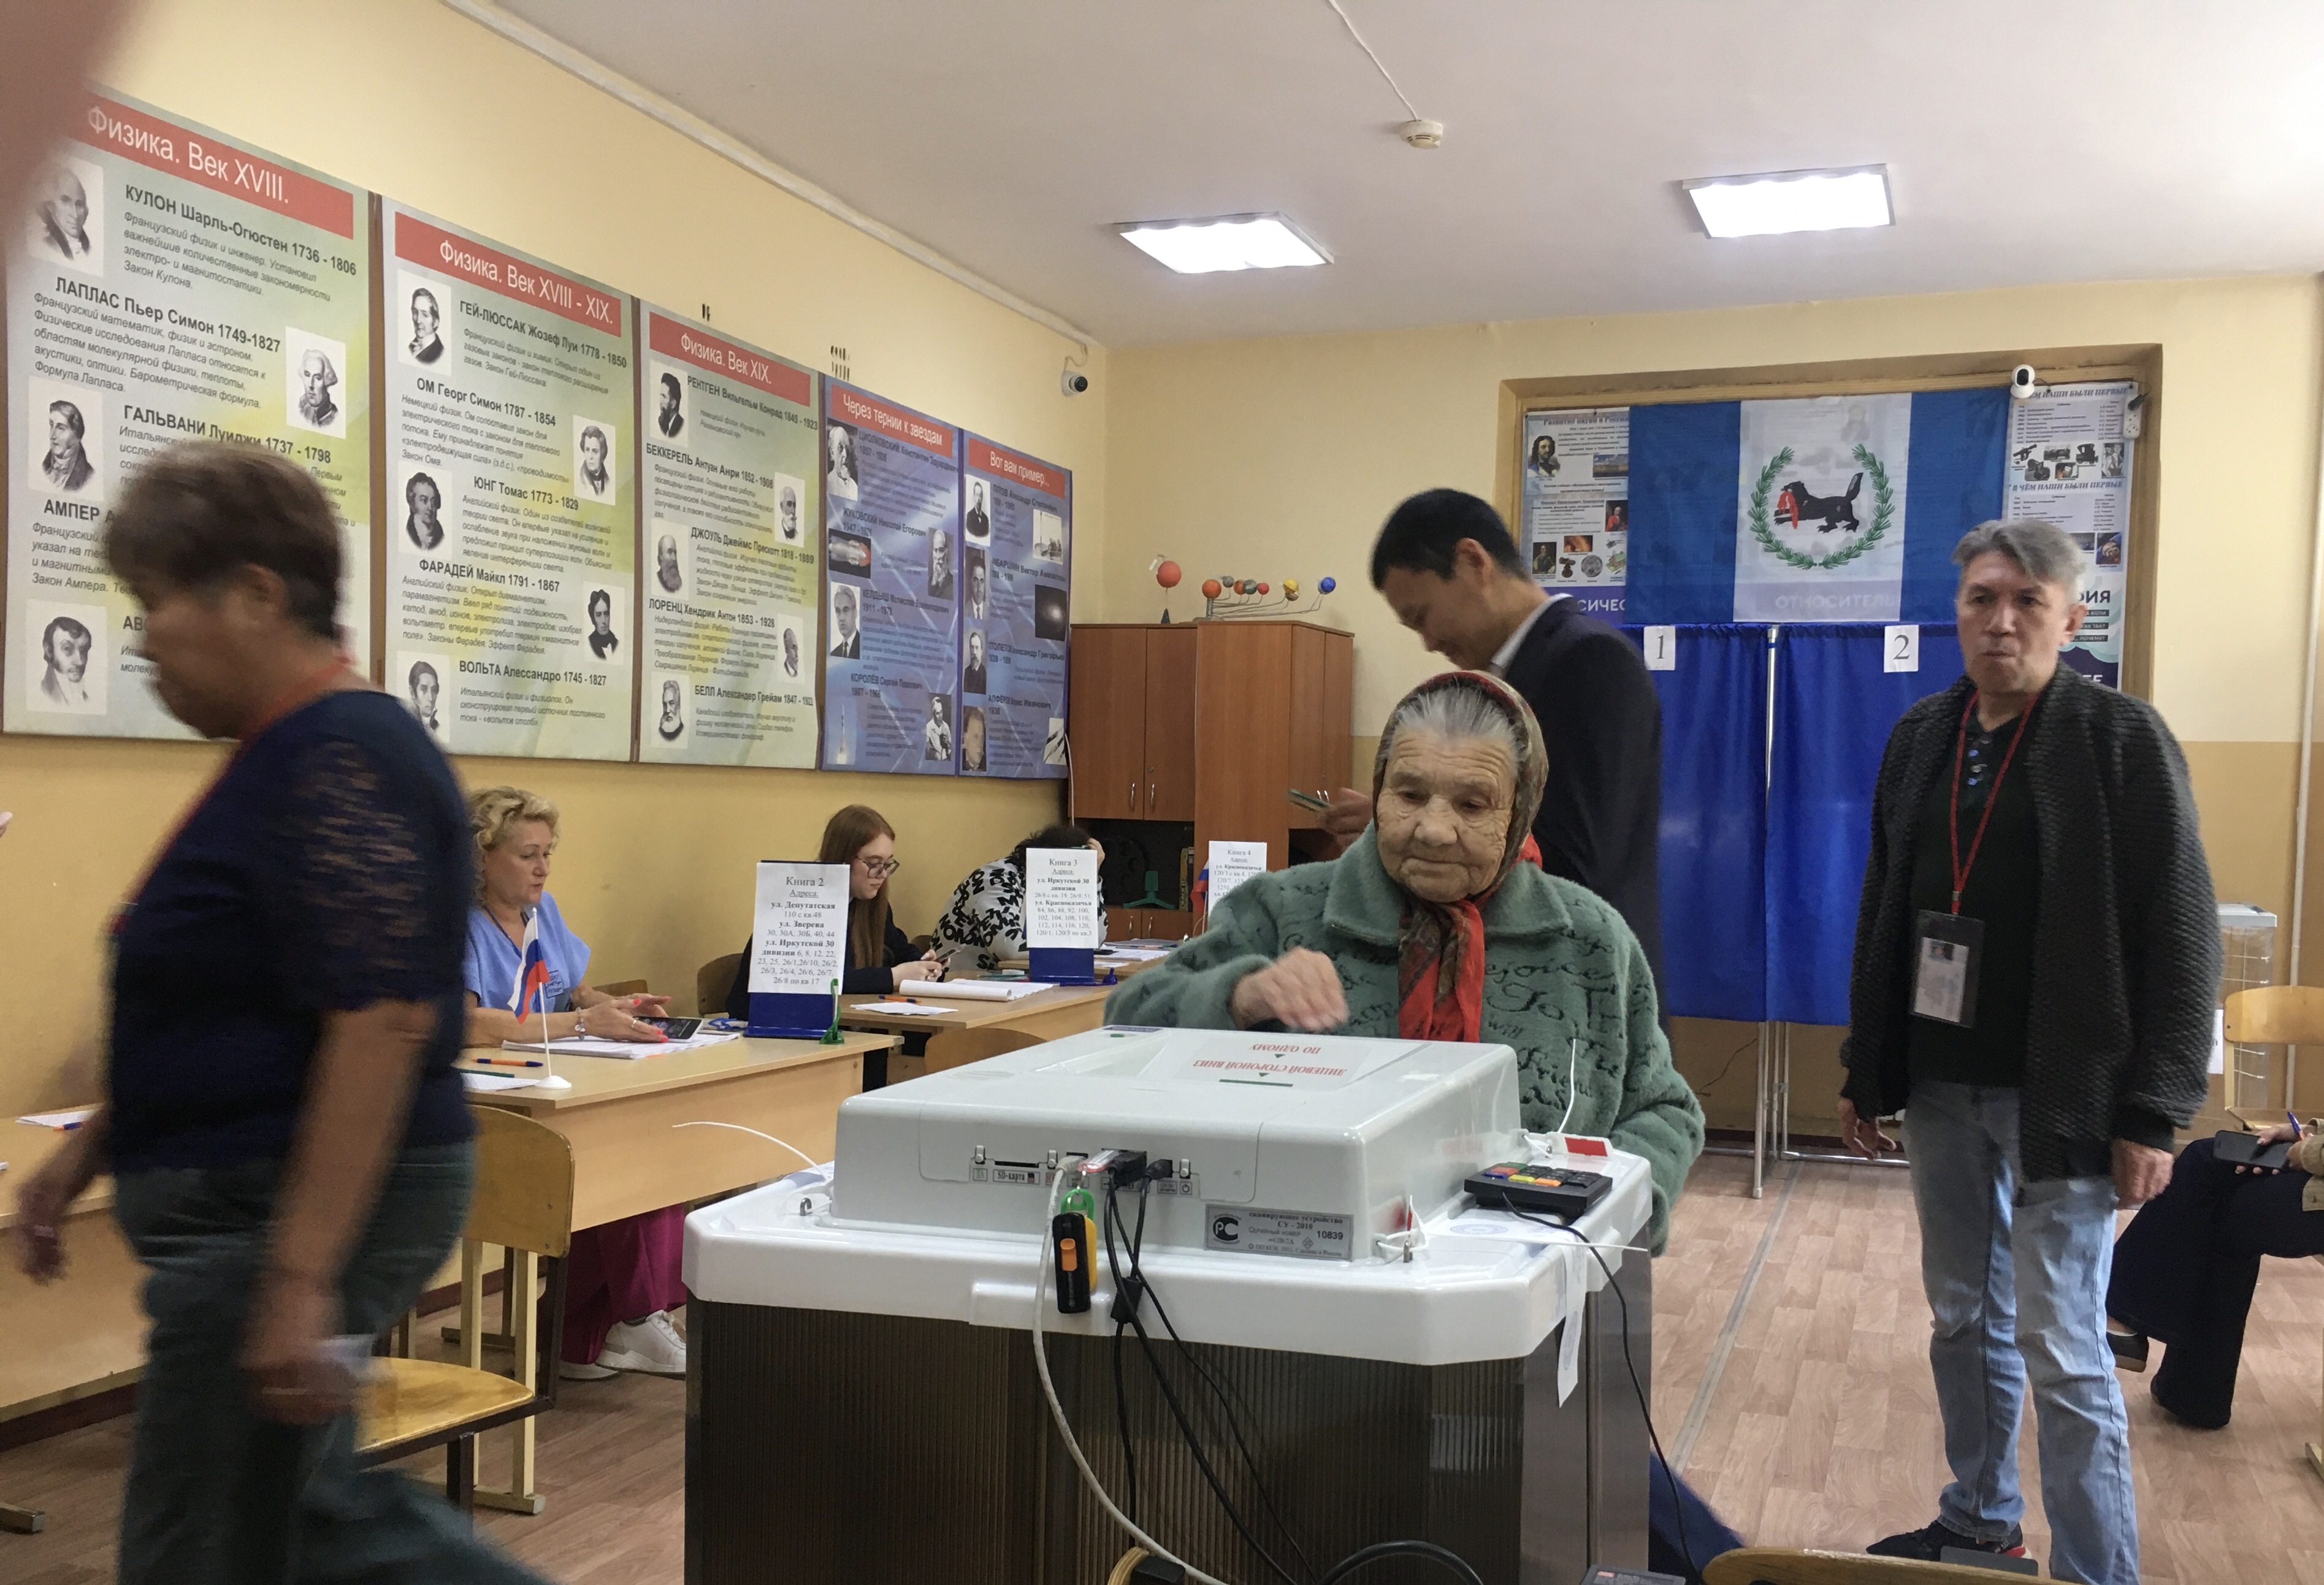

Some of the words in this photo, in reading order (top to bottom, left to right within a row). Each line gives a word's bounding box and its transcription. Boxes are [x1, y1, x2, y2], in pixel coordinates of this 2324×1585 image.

[88, 105, 179, 163] Физика.
[189, 142, 228, 181] Век
[234, 159, 288, 203] XVIII.
[126, 185, 176, 214] КУЛОН
[182, 203, 287, 252] Шарль-Огюстен
[292, 243, 319, 262] 1736
[331, 256, 356, 275] 1806
[124, 212, 188, 240] Французский
[190, 233, 218, 250] физик
[228, 247, 266, 266] инженер.
[270, 259, 316, 281] Установил
[124, 229, 180, 253] важнейшие
[183, 248, 258, 278] количественные
[261, 273, 330, 301] закономерности
[124, 246, 170, 265] электро-
[182, 263, 262, 295] магнитостатики.
[124, 260, 153, 277] Закон
[156, 269, 193, 289] Кулона.
[440, 240, 502, 283] Физика.
[508, 264, 535, 295] Век
[539, 277, 571, 308] XVIII
[586, 294, 612, 324] XIX.
[34, 292, 98, 319] Французский
[101, 313, 164, 338] математик,
[168, 330, 197, 345] физик
[207, 342, 252, 361] астроном.
[56, 277, 119, 308] ЛАПЛАС
[124, 297, 163, 323] Пьер
[168, 309, 213, 334] Симон
[218, 324, 280, 352] 1749-1827
[34, 310, 93, 334] Физические
[95, 329, 165, 353] исследования
[167, 345, 206, 364] Лапласа
[208, 358, 259, 377] относятся
[460, 300, 526, 334] ГЕЙ-ЛЮССАК
[528, 324, 559, 347] Жозеф
[562, 337, 577, 352] Луи
[581, 343, 600, 359] 1778
[607, 353, 626, 368] 1850
[34, 327, 85, 348] областям
[87, 343, 159, 367] молекулярной
[161, 360, 197, 377] физики,
[201, 372, 245, 390] теплоты,
[681, 333, 725, 366] Физика.
[728, 350, 747, 375] Век
[751, 359, 771, 384] XIX.
[34, 345, 83, 367] акустики,
[86, 359, 126, 376] оптики.
[130, 367, 217, 397] Барометрическая
[219, 391, 260, 408] формула.
[35, 361, 78, 380] Формула
[81, 372, 124, 392] Лапласа.
[417, 378, 434, 393] ОМ
[438, 383, 467, 403] Георг
[470, 392, 501, 411] Симон
[504, 403, 525, 418] 1787
[534, 411, 556, 426] 1854
[124, 405, 205, 435] ГАЛЬВАНИ
[266, 437, 293, 454] 1737
[305, 446, 331, 463] 1798
[844, 394, 871, 419] Через
[873, 409, 901, 430] тернии
[904, 421, 908, 433] к
[910, 423, 942, 445] звездам
[646, 443, 693, 465] БЕККЕРЕЛЬ
[695, 457, 717, 473] Антуан
[719, 465, 740, 479] Анри
[741, 470, 754, 483] 1852
[990, 451, 1003, 468] Вот
[1004, 460, 1017, 474] вам
[474, 476, 496, 491] ЮНГ
[499, 482, 527, 499] Томас
[531, 490, 552, 504] 1773
[561, 496, 578, 510] 1829
[44, 499, 99, 521] АМПЕР
[32, 572, 62, 586] Закон
[64, 577, 108, 592] Ампера.
[419, 559, 473, 578] ФАРАДЕЙ
[476, 568, 505, 584] Майкл
[508, 574, 528, 587] 1791
[538, 579, 559, 592] 1867
[649, 598, 682, 614] ЛОРЕНЦ
[684, 604, 716, 619] Хендрик
[717, 609, 735, 621] Антон
[737, 613, 754, 624] 1853
[760, 617, 774, 627] 1928
[1656, 634, 1665, 660] 1
[1893, 635, 1910, 660] 2
[459, 660, 501, 676] ВОЛЬТА
[503, 665, 560, 683] Алессандро
[564, 671, 582, 684] 1745
[589, 674, 606, 686] 1827
[786, 876, 815, 886] Книга
[818, 877, 824, 887] 2
[784, 901, 835, 910] Депутатская
[794, 920, 824, 929] Зверева
[779, 939, 823, 947] Иркутской
[1193, 1060, 1226, 1068] ВНИЗ
[1248, 1044, 1299, 1053] ОДНОМУ
[1225, 1061, 1288, 1072] СТОРОНОЙ
[1289, 1066, 1348, 1077] ЛИЦЕВОЙ
[997, 1171, 1025, 1182] SD-карта
[1317, 1231, 1343, 1240] 10839
